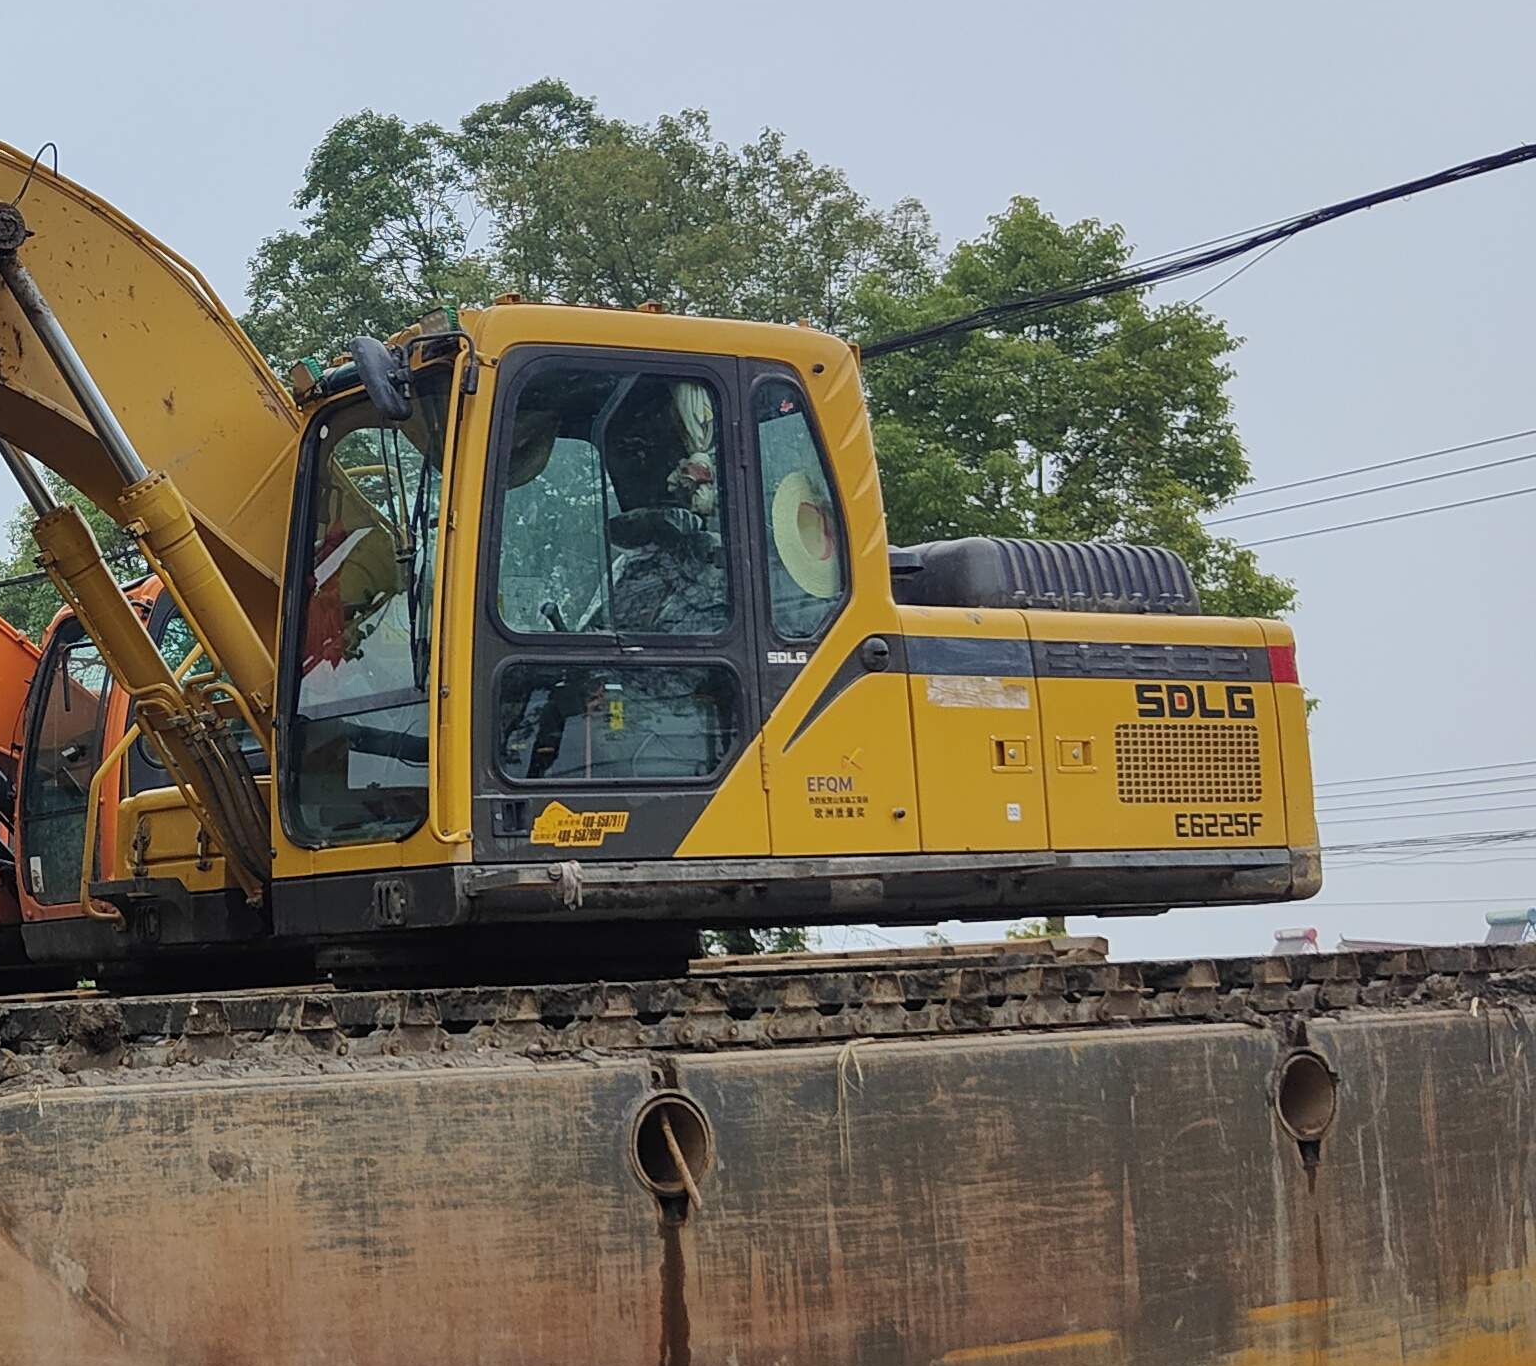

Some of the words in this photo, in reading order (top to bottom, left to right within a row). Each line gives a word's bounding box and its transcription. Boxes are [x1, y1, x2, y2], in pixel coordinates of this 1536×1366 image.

[767, 651, 807, 664] SDLG
[1135, 684, 1255, 718] SDLG
[807, 776, 853, 793] EFQM
[1175, 813, 1263, 837] E6225F
